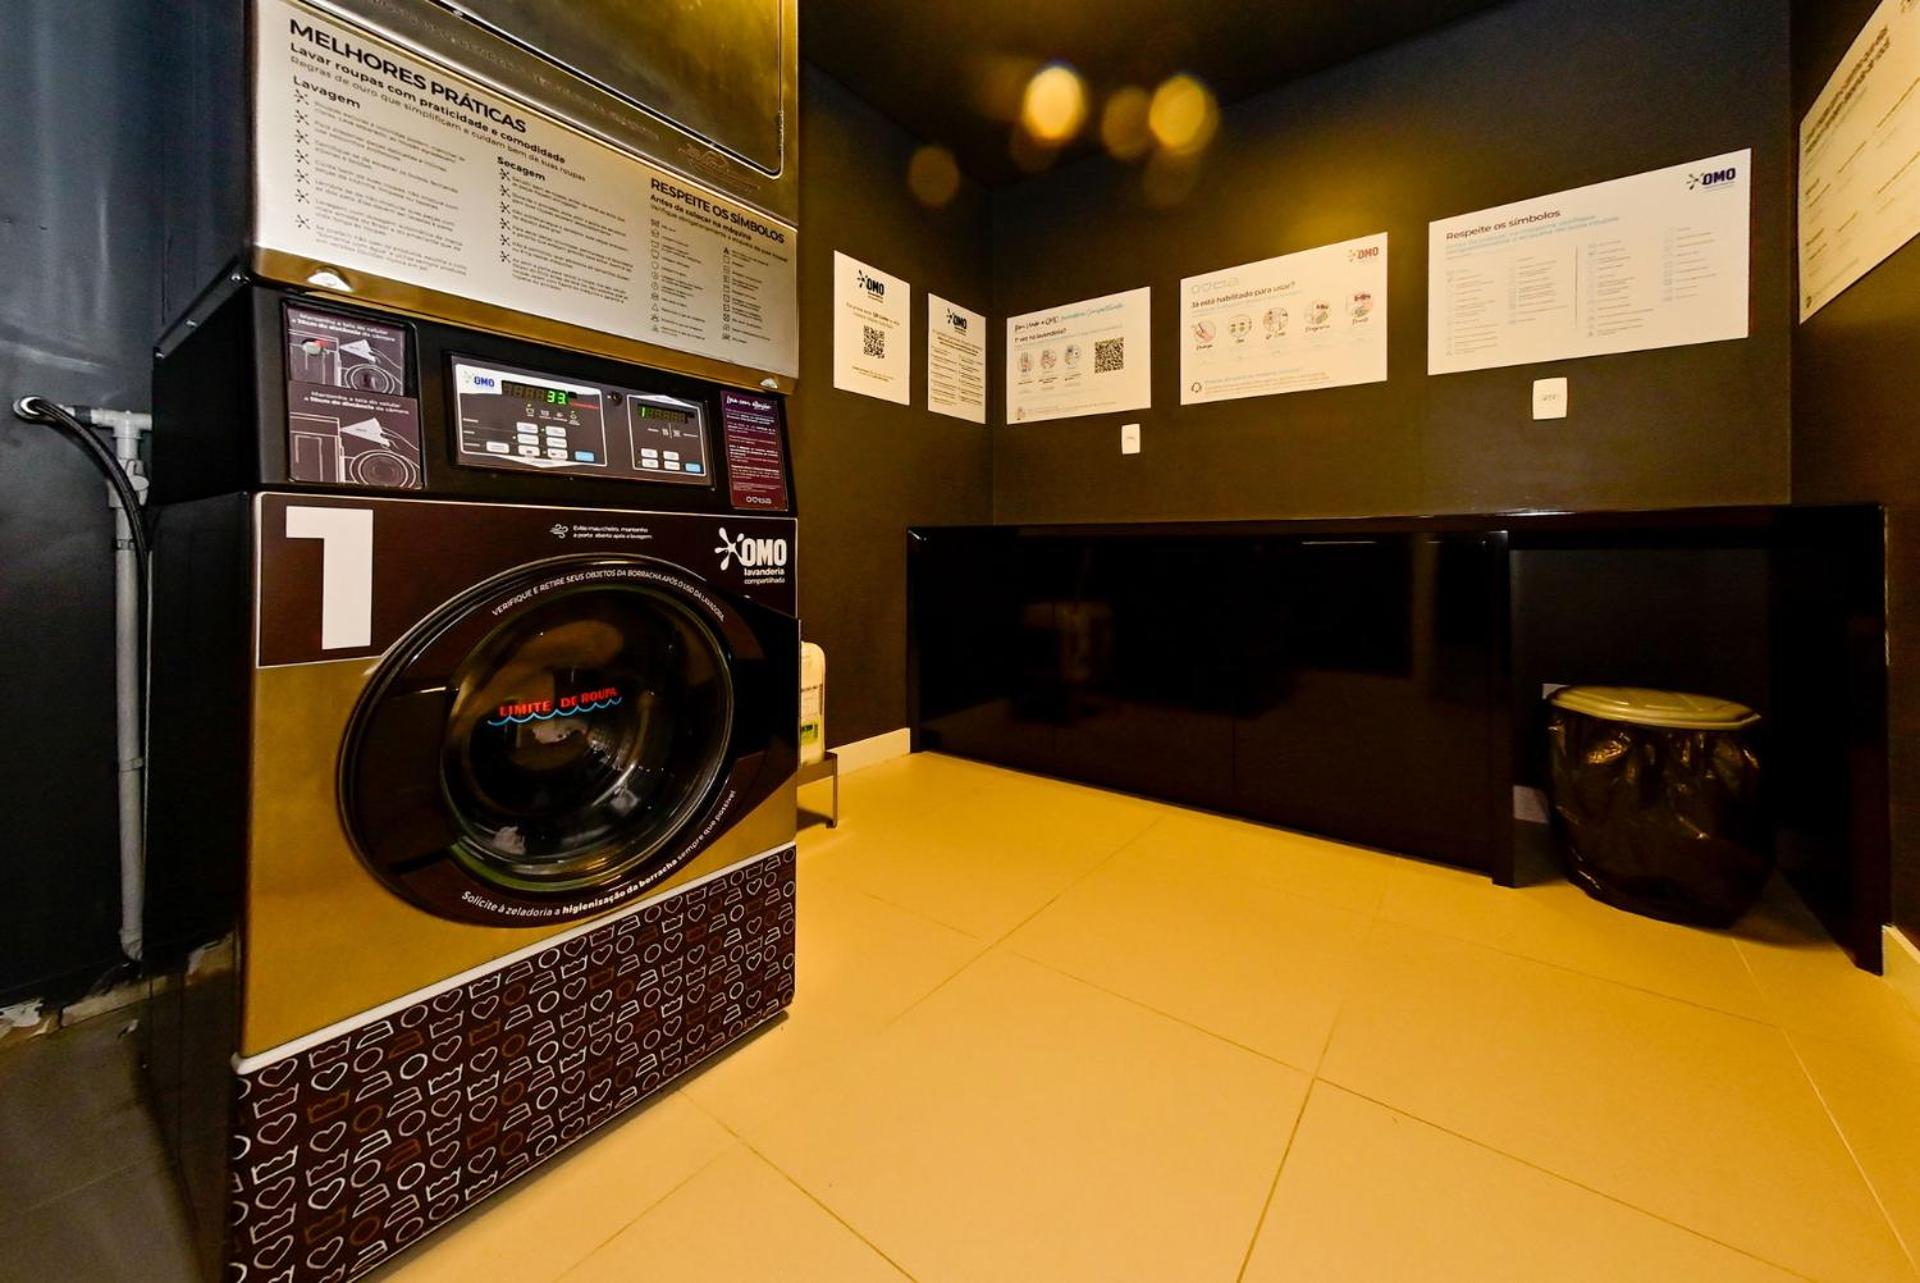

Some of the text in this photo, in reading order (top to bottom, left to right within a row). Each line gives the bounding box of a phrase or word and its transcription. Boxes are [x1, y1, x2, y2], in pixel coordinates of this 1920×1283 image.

[290, 19, 426, 90] MELHORES
[431, 81, 526, 133] PRÁTICAS
[291, 42, 331, 67] Lavar
[335, 60, 384, 89] roupas
[387, 84, 416, 102] com
[419, 96, 489, 132] praticidade
[491, 128, 498, 136] e
[501, 131, 566, 164] comodidade
[293, 75, 361, 109] Lavagem
[290, 55, 331, 81] Regras
[334, 73, 350, 85] de
[352, 82, 378, 97] ouro
[380, 92, 401, 108] que
[403, 101, 462, 131] simplificam
[471, 129, 505, 149] cuidam
[507, 143, 527, 158] bem
[559, 166, 586, 181] roupas
[497, 155, 546, 182] Secagem
[1702, 167, 1736, 186] OMO
[650, 194, 673, 209] Antes
[674, 203, 684, 213] de
[651, 178, 711, 212] RESPEITE
[712, 206, 730, 220] OS
[731, 212, 785, 244] SÍMBOLOS
[1445, 209, 1561, 240] Respeite os símbolos
[1357, 246, 1379, 259] OMO
[866, 277, 885, 296] OMO
[473, 376, 495, 388] OMO
[547, 391, 567, 405] 33
[741, 538, 787, 567] OMO
[285, 505, 374, 650] 1
[744, 567, 785, 576] lavanderia
[491, 589, 533, 616] VERIFIQUE
[533, 586, 539, 595] E
[540, 577, 565, 591] RETIRE
[566, 573, 585, 583] SEUS
[585, 569, 615, 579] OBJETOS
[616, 569, 627, 577] DA
[499, 687, 618, 717] LIMITE DE ROUPA
[462, 890, 499, 913] Solicite
[505, 906, 552, 917] zeladoria
[562, 890, 626, 915] higienização
[626, 883, 639, 894] da
[639, 859, 678, 888] borracha
[677, 834, 704, 860] sempre
[703, 820, 716, 836] que
